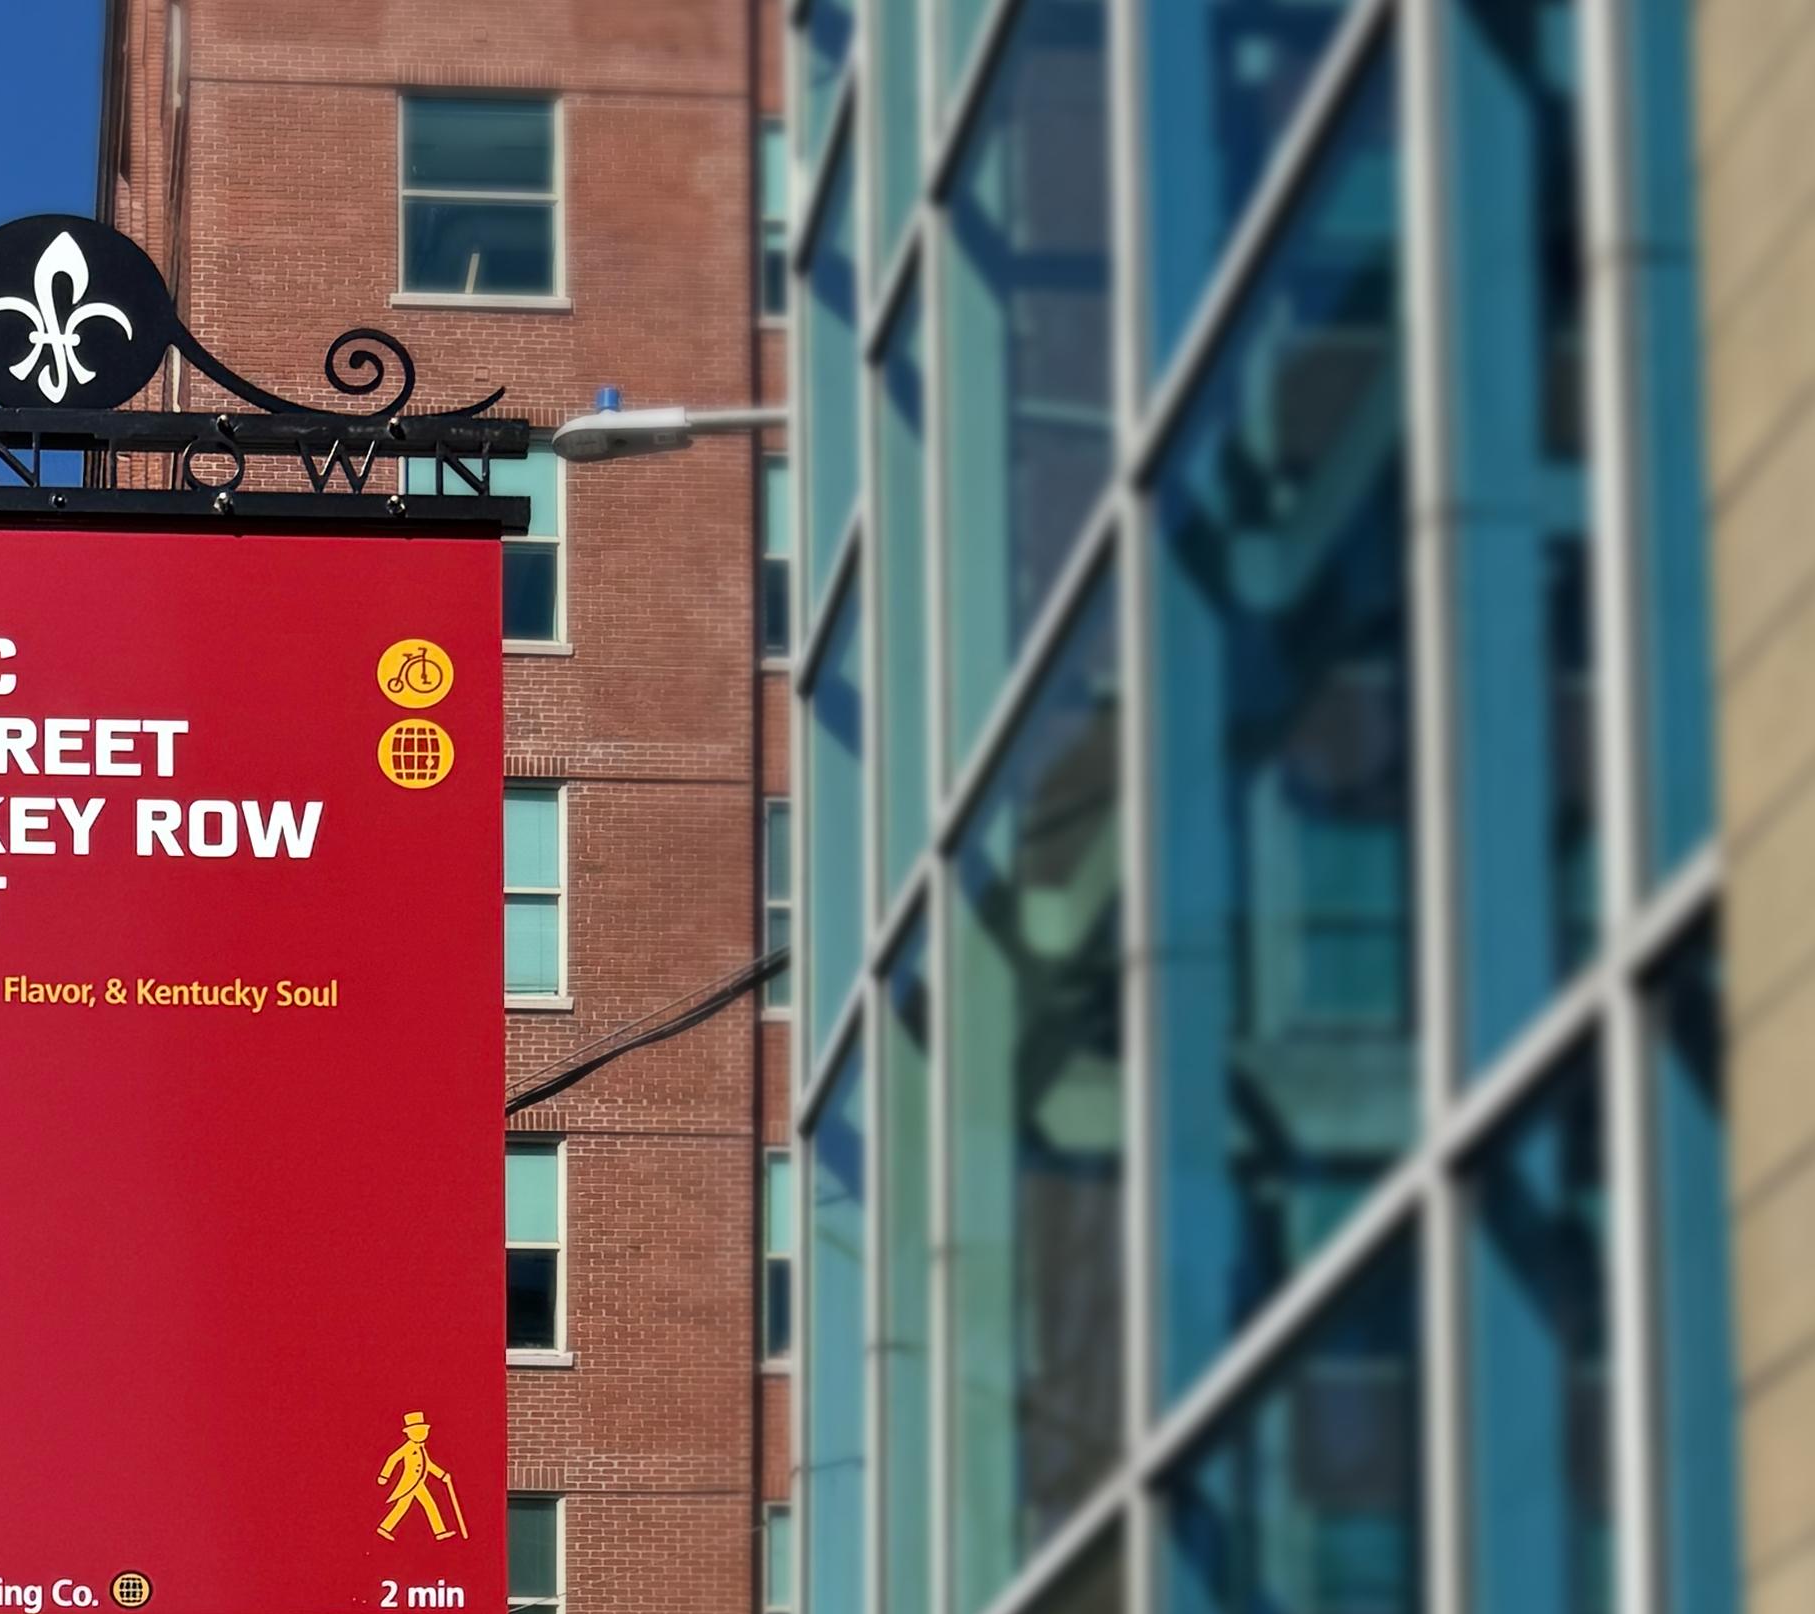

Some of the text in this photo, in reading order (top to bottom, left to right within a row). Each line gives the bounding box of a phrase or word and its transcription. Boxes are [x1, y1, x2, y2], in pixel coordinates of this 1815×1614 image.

[135, 797, 325, 860] ROW
[3, 975, 96, 1008] Flavor,
[104, 978, 127, 1004] &
[137, 978, 268, 1013] Kentucky
[276, 978, 338, 1008] Soul
[51, 1578, 99, 1607] Co.
[380, 1579, 465, 1608] 2 min
